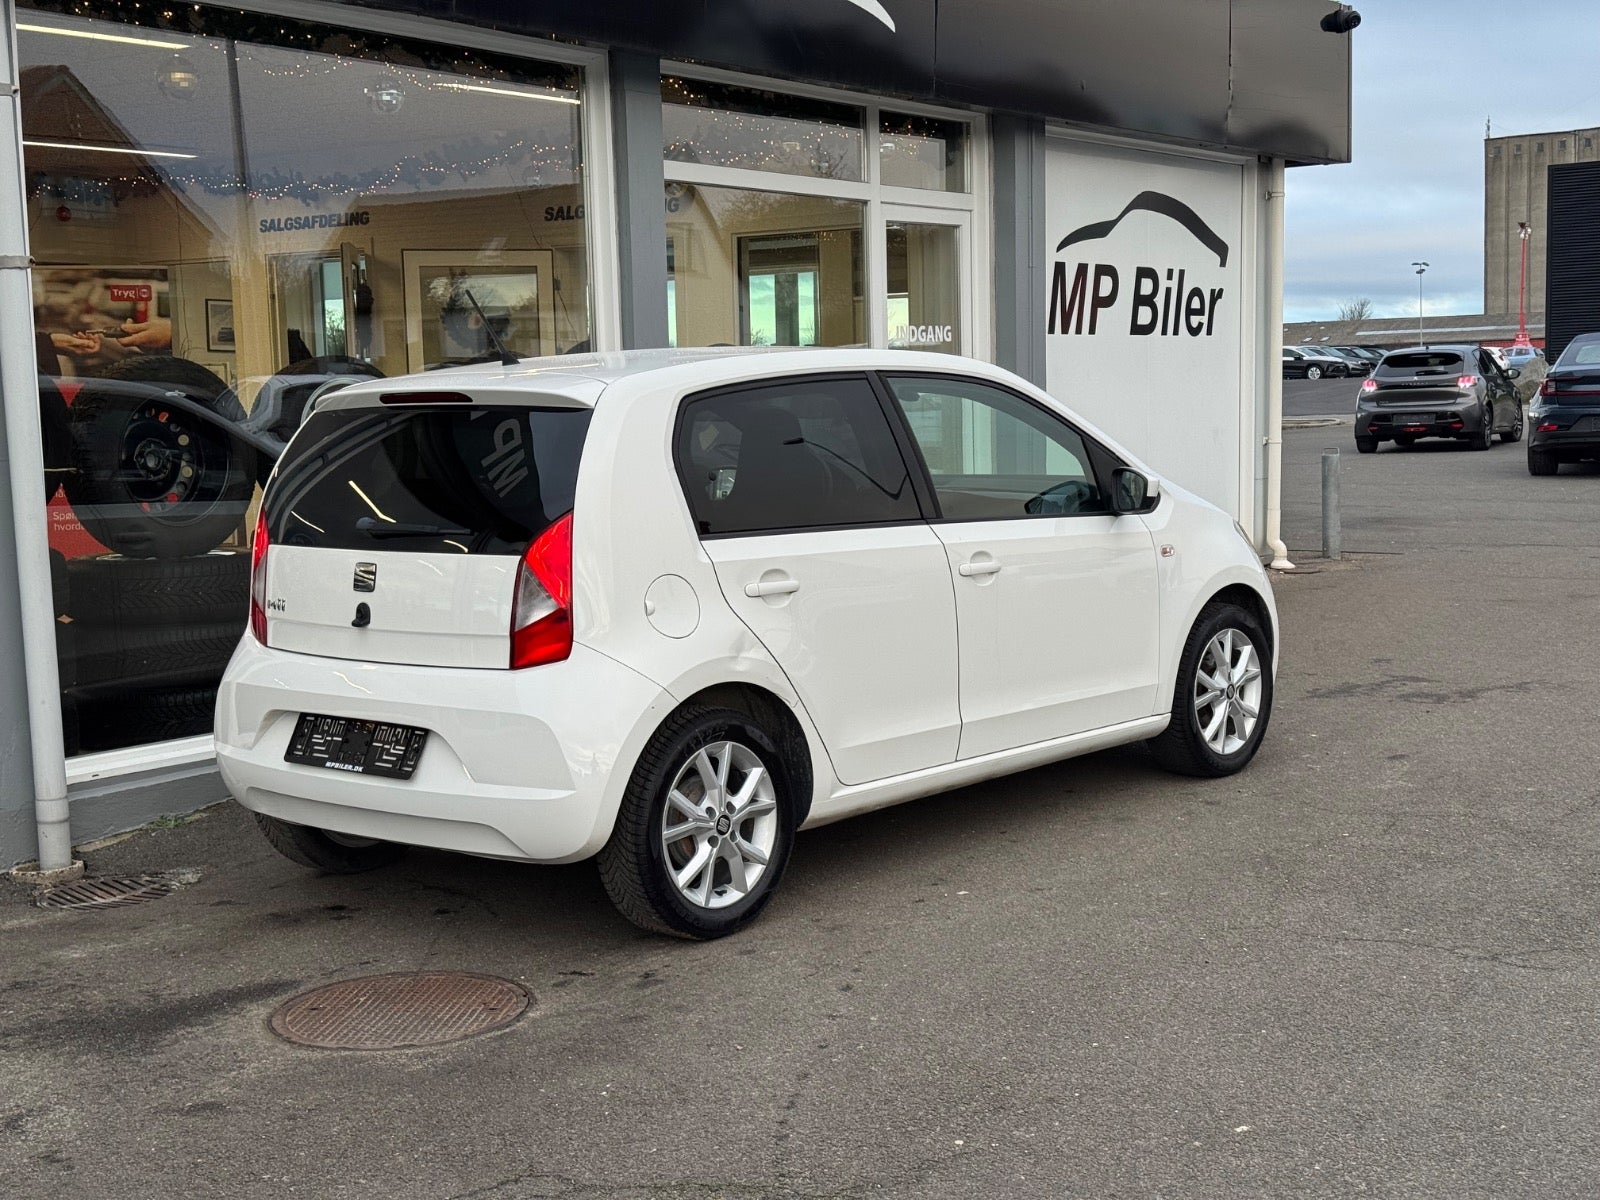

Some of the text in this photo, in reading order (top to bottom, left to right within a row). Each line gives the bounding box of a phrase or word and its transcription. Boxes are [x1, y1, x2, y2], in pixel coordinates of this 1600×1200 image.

[544, 204, 585, 221] SALG
[259, 210, 370, 233] SALGSAFDELING
[112, 288, 136, 299] Tryg
[1048, 261, 1224, 337] MP Biler
[896, 325, 952, 342] INDGANG
[52, 511, 77, 521] Spør
